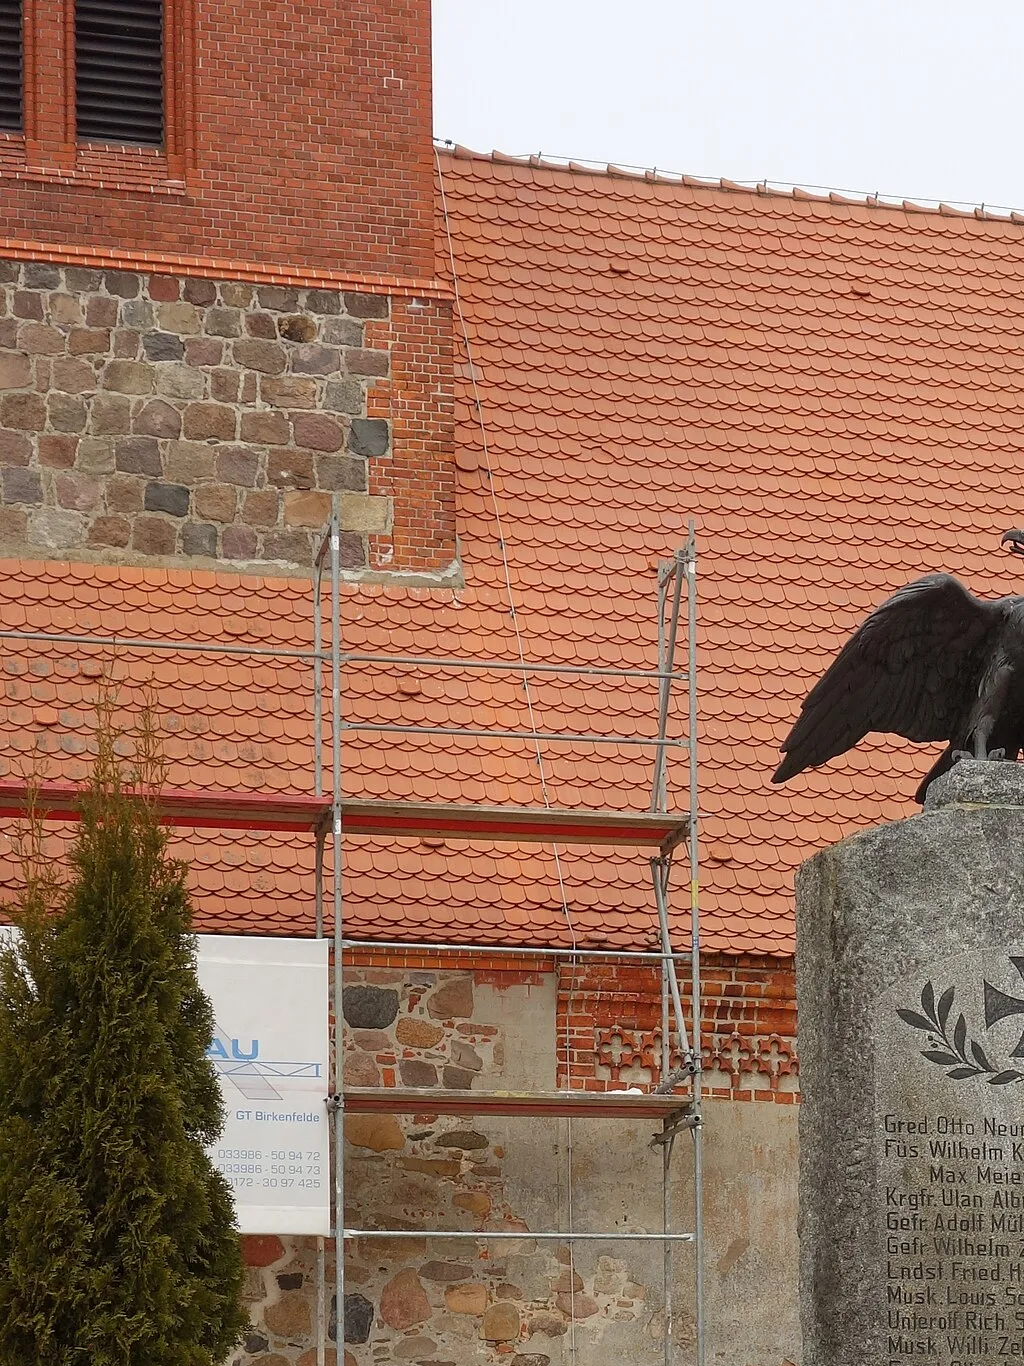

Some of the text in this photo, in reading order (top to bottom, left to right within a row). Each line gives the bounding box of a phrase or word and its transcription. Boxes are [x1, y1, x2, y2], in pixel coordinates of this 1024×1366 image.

[206, 1039, 258, 1060] AU
[236, 1110, 320, 1123] GT Birkenfelde
[937, 1116, 975, 1135] Otto
[218, 1149, 262, 1160] 033986
[271, 1151, 286, 1161] 50
[288, 1151, 303, 1161] 94
[305, 1152, 320, 1161] 72
[929, 1141, 1002, 1161] Wilhelm
[218, 1163, 262, 1174] 033986
[271, 1165, 286, 1175] 50
[288, 1166, 303, 1176] 94
[305, 1166, 320, 1176] 73
[930, 1165, 967, 1184] Max
[262, 1178, 278, 1188] 30
[280, 1179, 295, 1189] 97
[298, 1179, 320, 1189] 425
[941, 1189, 983, 1208] Ulan
[934, 1213, 984, 1232] Adolf
[933, 1237, 1010, 1257] Wilhelm
[886, 1286, 943, 1306] Musk.
[947, 1286, 996, 1306] Louis
[947, 1335, 989, 1355] Willi
